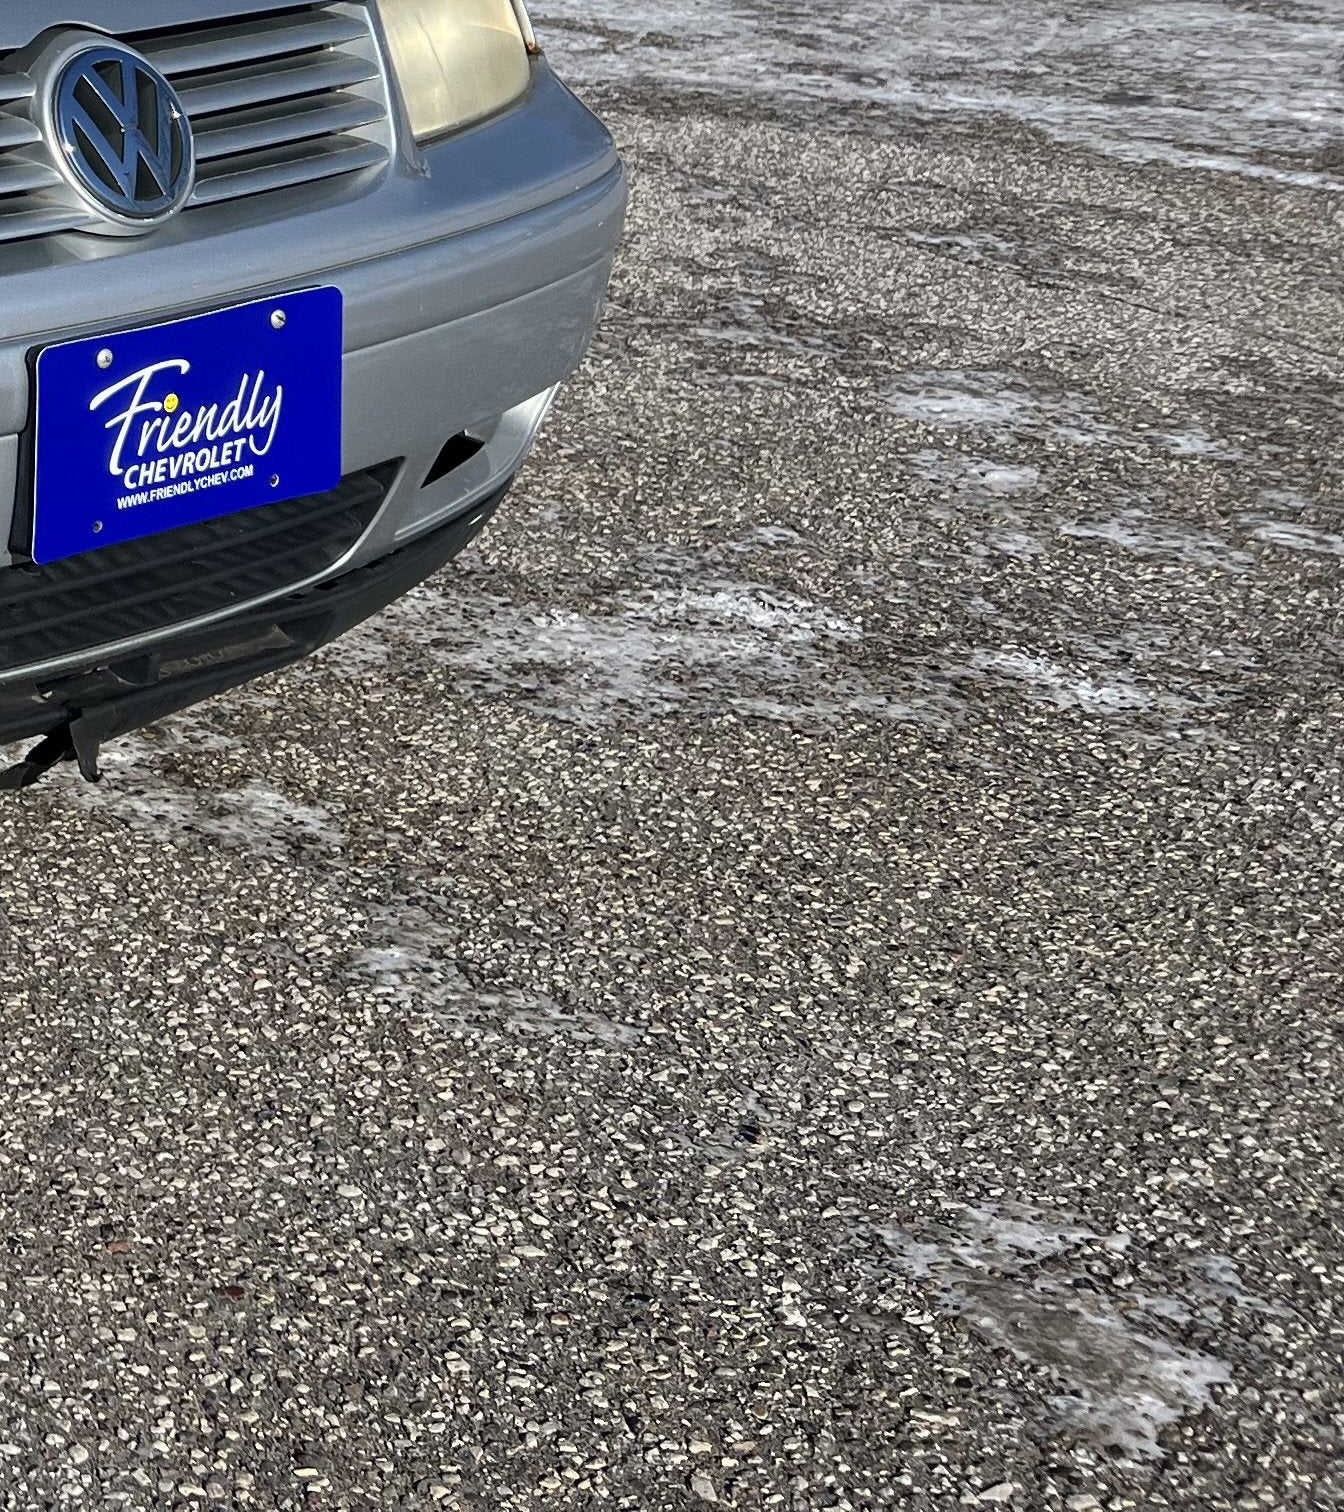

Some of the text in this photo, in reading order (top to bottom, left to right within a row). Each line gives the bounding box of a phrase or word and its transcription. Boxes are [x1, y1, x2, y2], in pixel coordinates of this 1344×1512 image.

[89, 358, 283, 476] Friendly
[116, 464, 255, 510] WWW.FRIENDLYCHEV.COM
[123, 437, 248, 489] CHEVROLET
